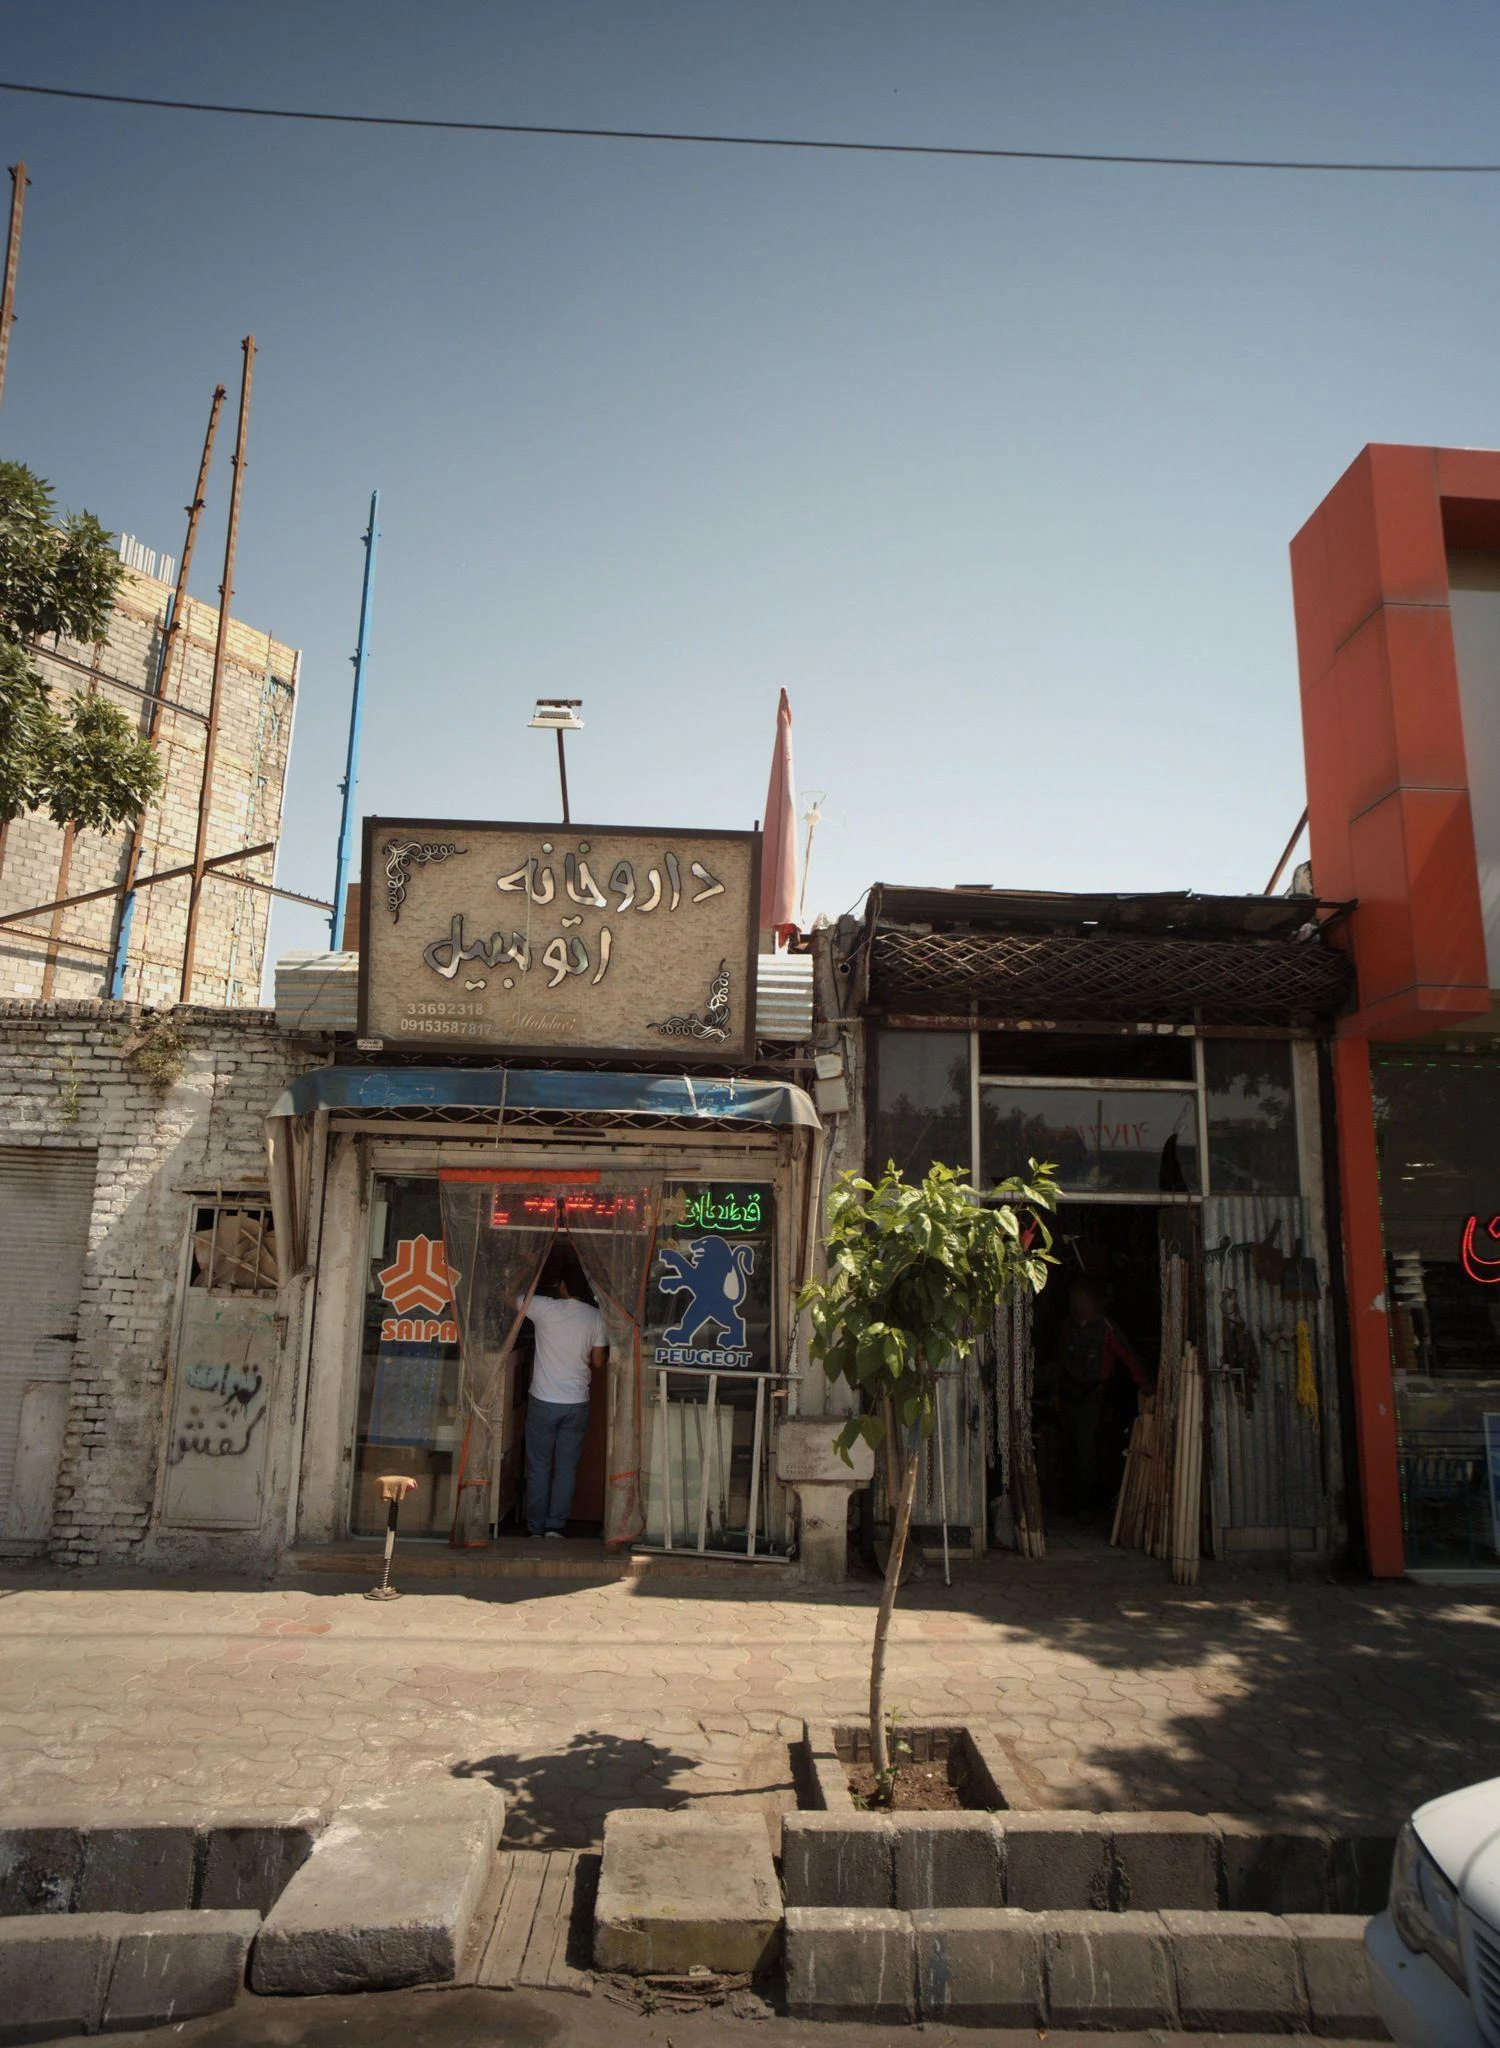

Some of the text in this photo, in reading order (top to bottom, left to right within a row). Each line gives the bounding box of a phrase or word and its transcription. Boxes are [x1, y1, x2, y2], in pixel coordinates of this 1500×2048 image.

[497, 842, 725, 912] داروخانه
[423, 913, 612, 991] اتومبیل
[407, 1003, 484, 1015] 33692318
[401, 1019, 493, 1035] 09153587817
[381, 1318, 458, 1343] SAIPA
[655, 1347, 752, 1367] PEUGEOT
